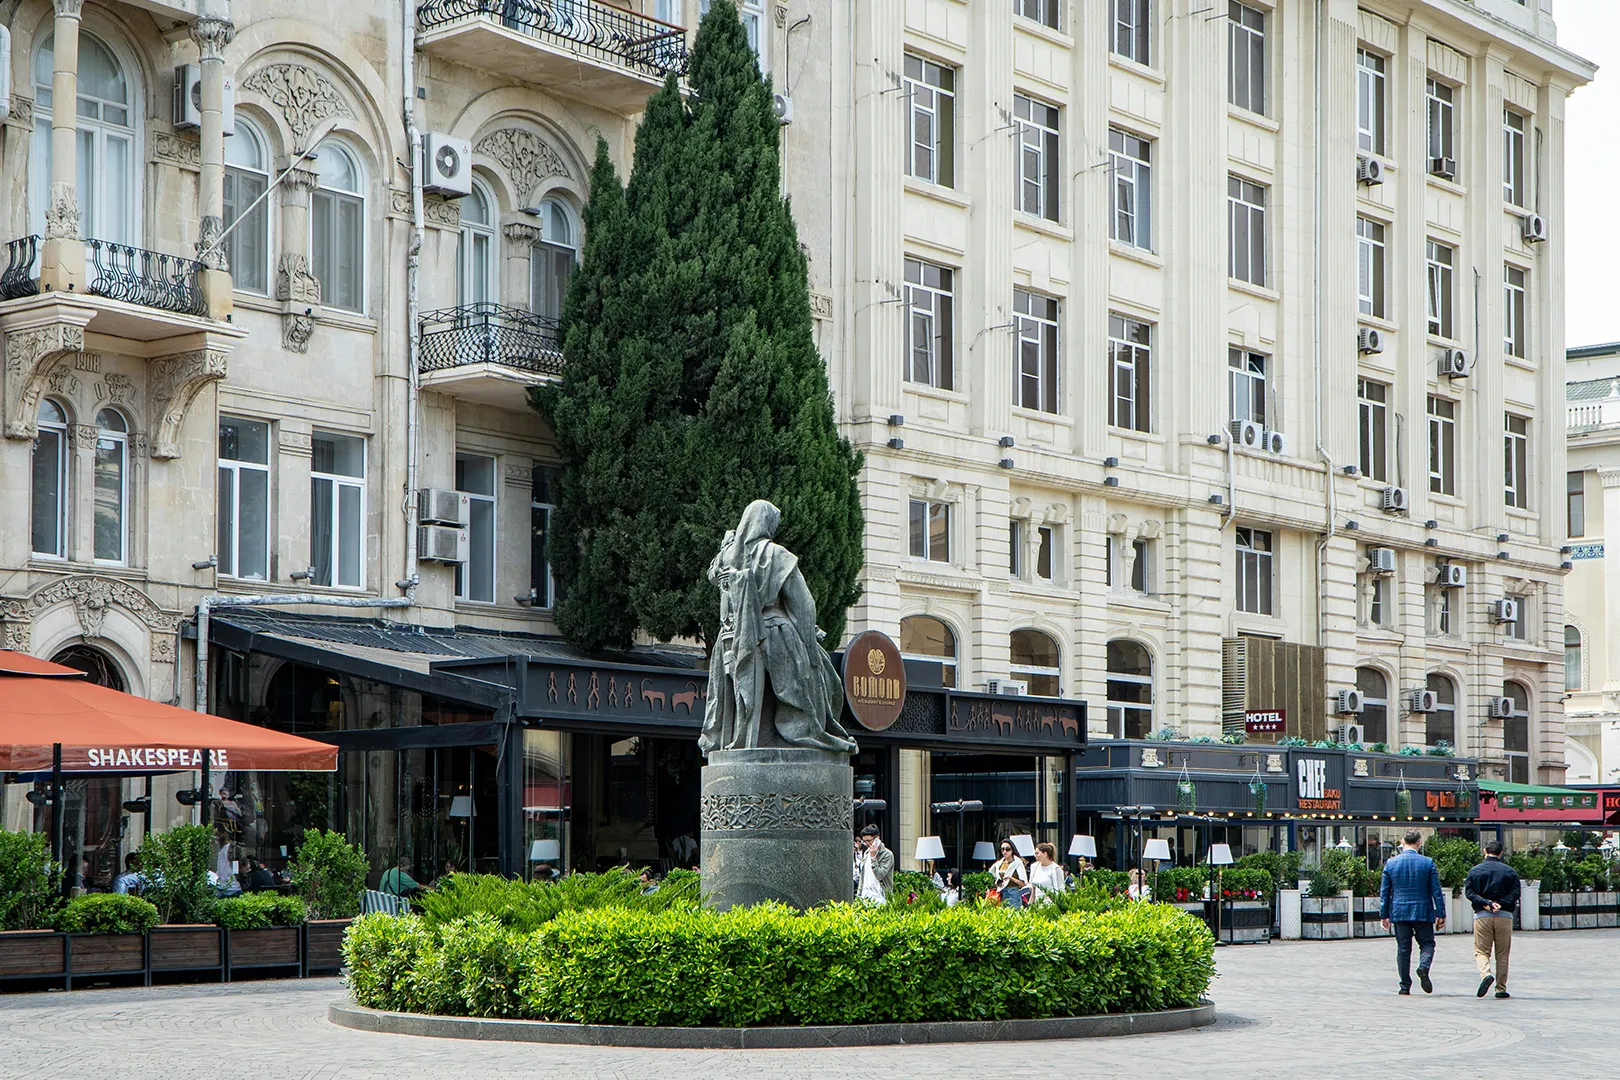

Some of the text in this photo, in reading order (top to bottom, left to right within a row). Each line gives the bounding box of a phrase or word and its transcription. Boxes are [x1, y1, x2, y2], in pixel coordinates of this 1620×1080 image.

[75, 353, 101, 374] 1908
[1245, 713, 1282, 722] HOTEL
[88, 749, 229, 766] SHAKESPEARE
[1298, 759, 1326, 798] CHEF
[1324, 788, 1341, 799] BAKU
[1426, 790, 1439, 812] by
[1299, 800, 1341, 809] RESTAURANT
